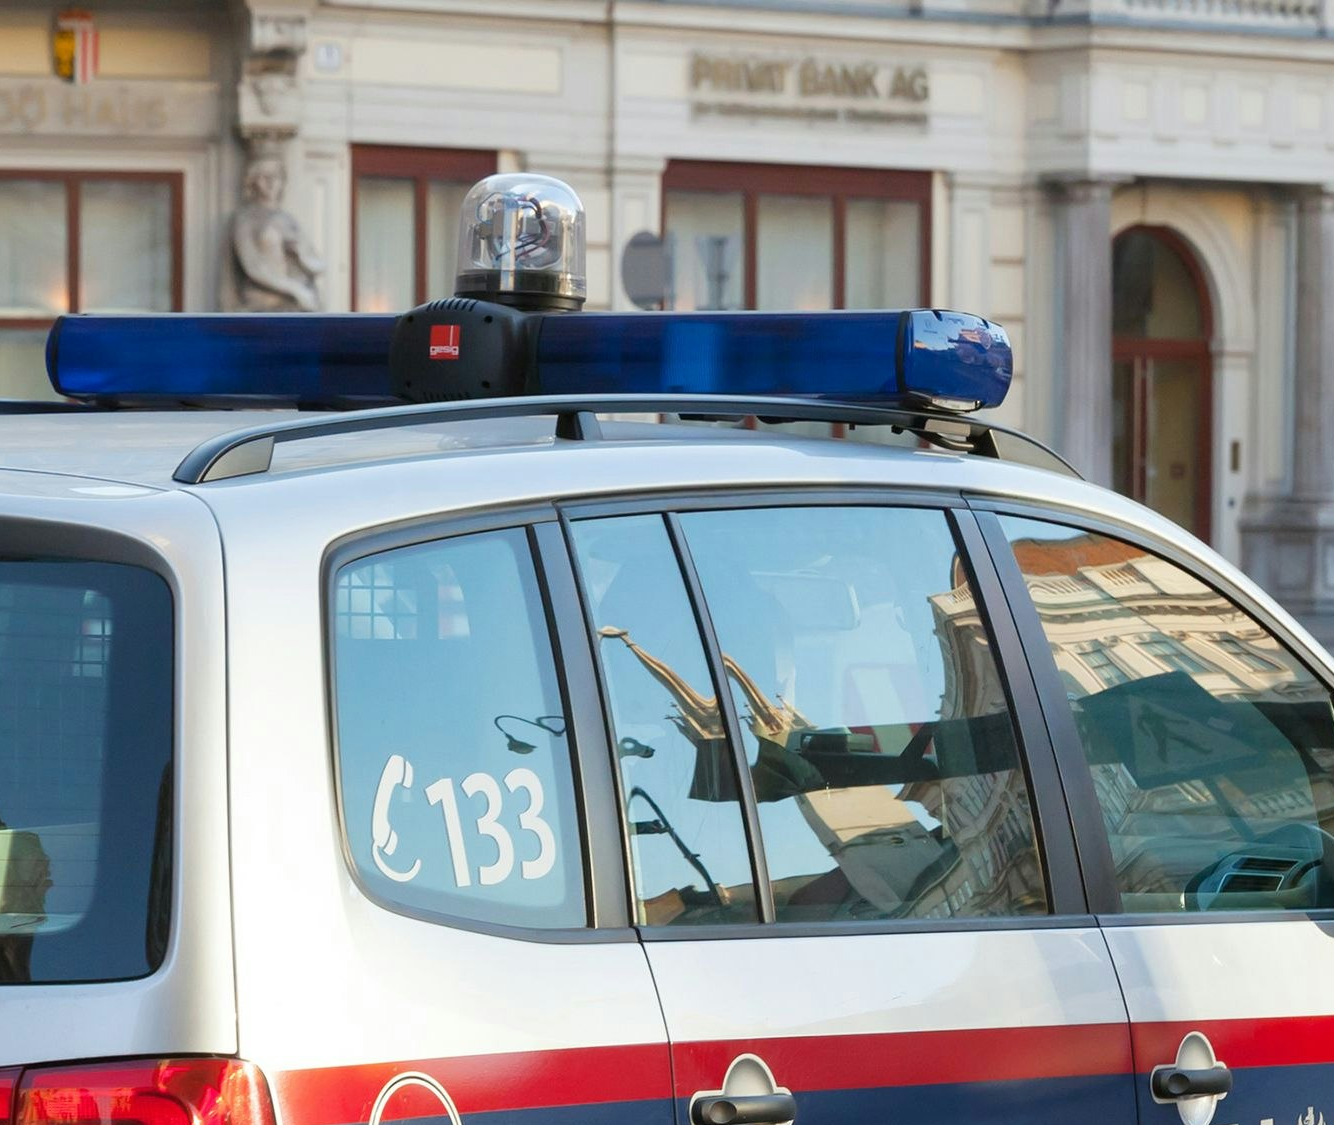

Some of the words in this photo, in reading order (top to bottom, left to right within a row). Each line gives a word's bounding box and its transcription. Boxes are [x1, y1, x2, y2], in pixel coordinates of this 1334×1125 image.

[690, 53, 790, 94] PRIVAT
[798, 57, 880, 99] BANK
[889, 64, 930, 102] AG
[424, 767, 556, 888] 133
